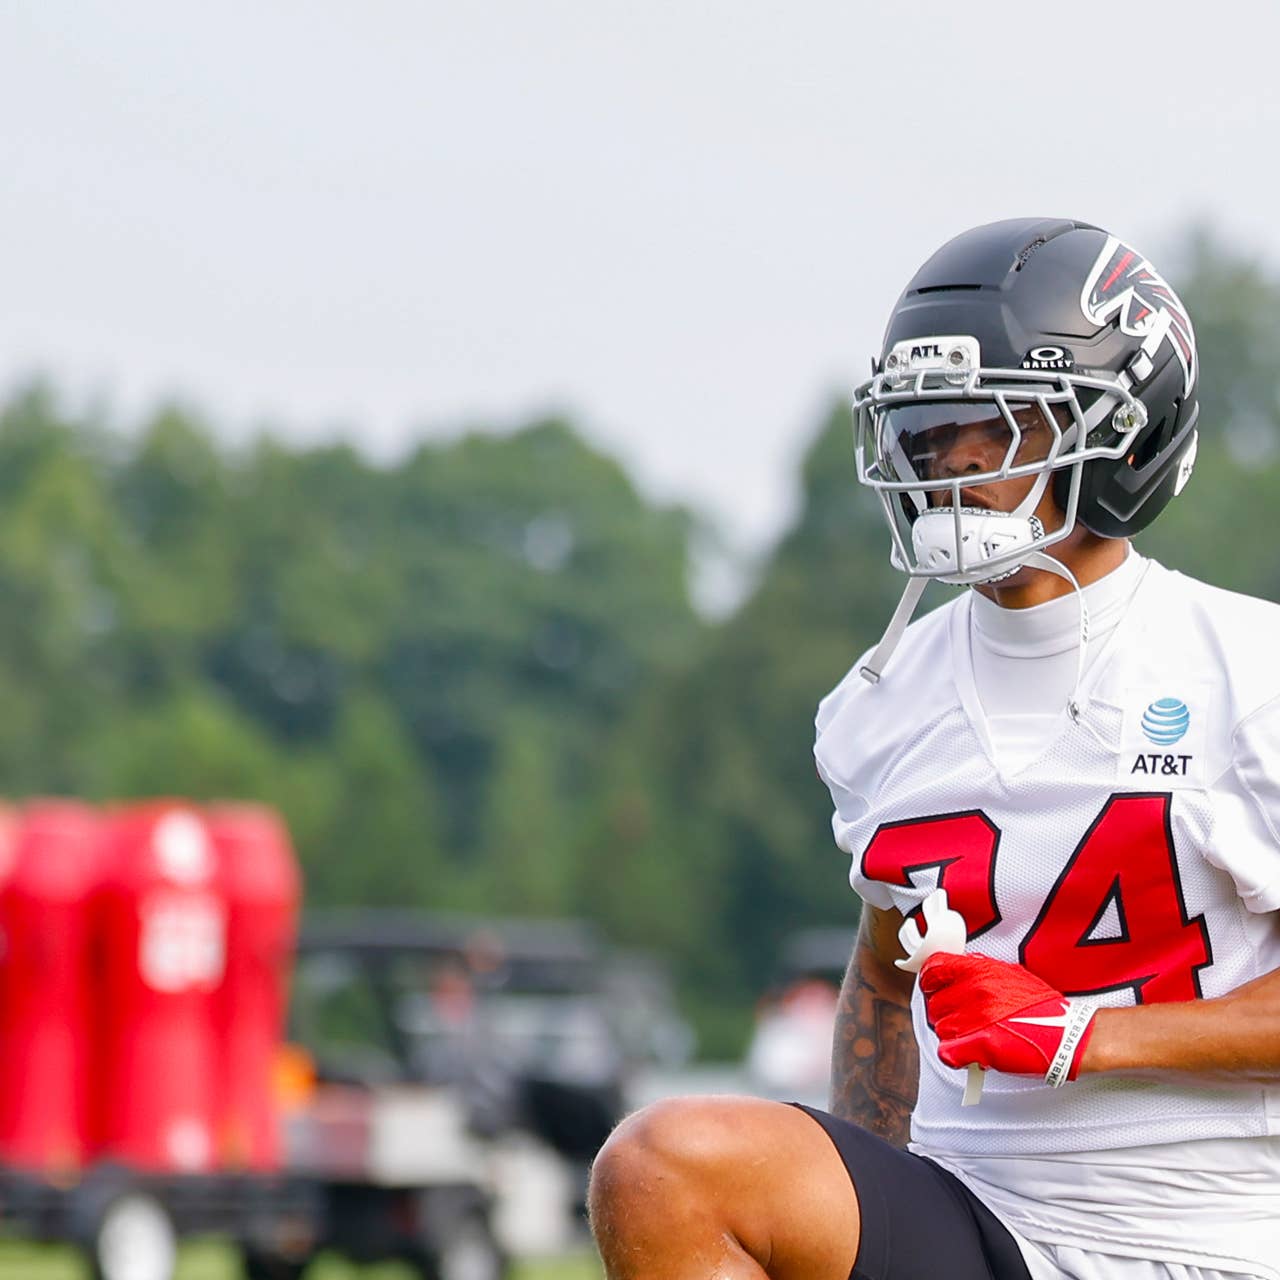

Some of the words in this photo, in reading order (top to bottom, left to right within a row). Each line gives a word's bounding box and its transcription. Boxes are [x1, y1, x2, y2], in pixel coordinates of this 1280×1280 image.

[910, 345, 942, 360] ATL
[1022, 360, 1074, 369] OAKLEY
[1131, 754, 1193, 776] AT&T
[1063, 1024, 1081, 1051] OVER
